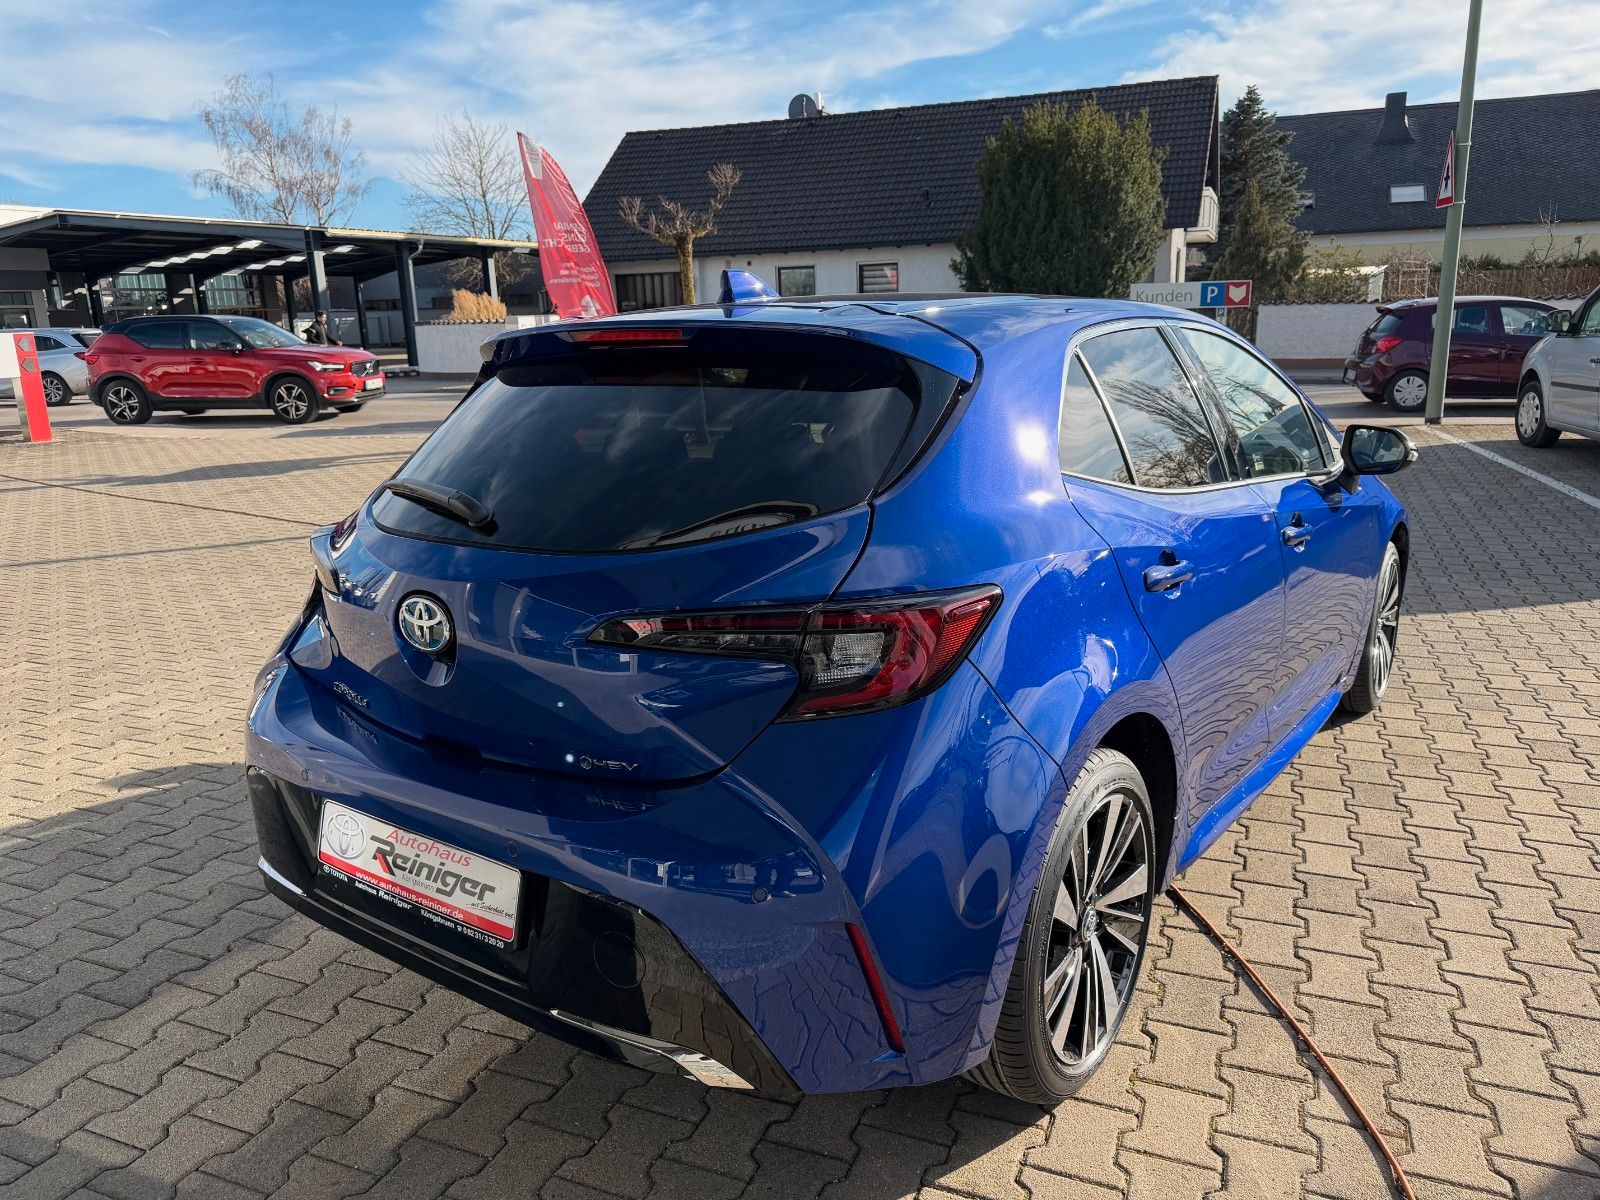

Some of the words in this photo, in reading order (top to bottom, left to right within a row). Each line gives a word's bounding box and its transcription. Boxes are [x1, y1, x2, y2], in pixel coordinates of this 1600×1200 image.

[1136, 290, 1193, 302] Kunden
[1207, 286, 1219, 304] P
[370, 834, 496, 901] Reiniger
[386, 829, 472, 867] Autohaus
[330, 868, 348, 883] TOYOTA
[378, 889, 413, 910] Reiniger
[355, 871, 464, 921] www.autohaus-reiniger.de
